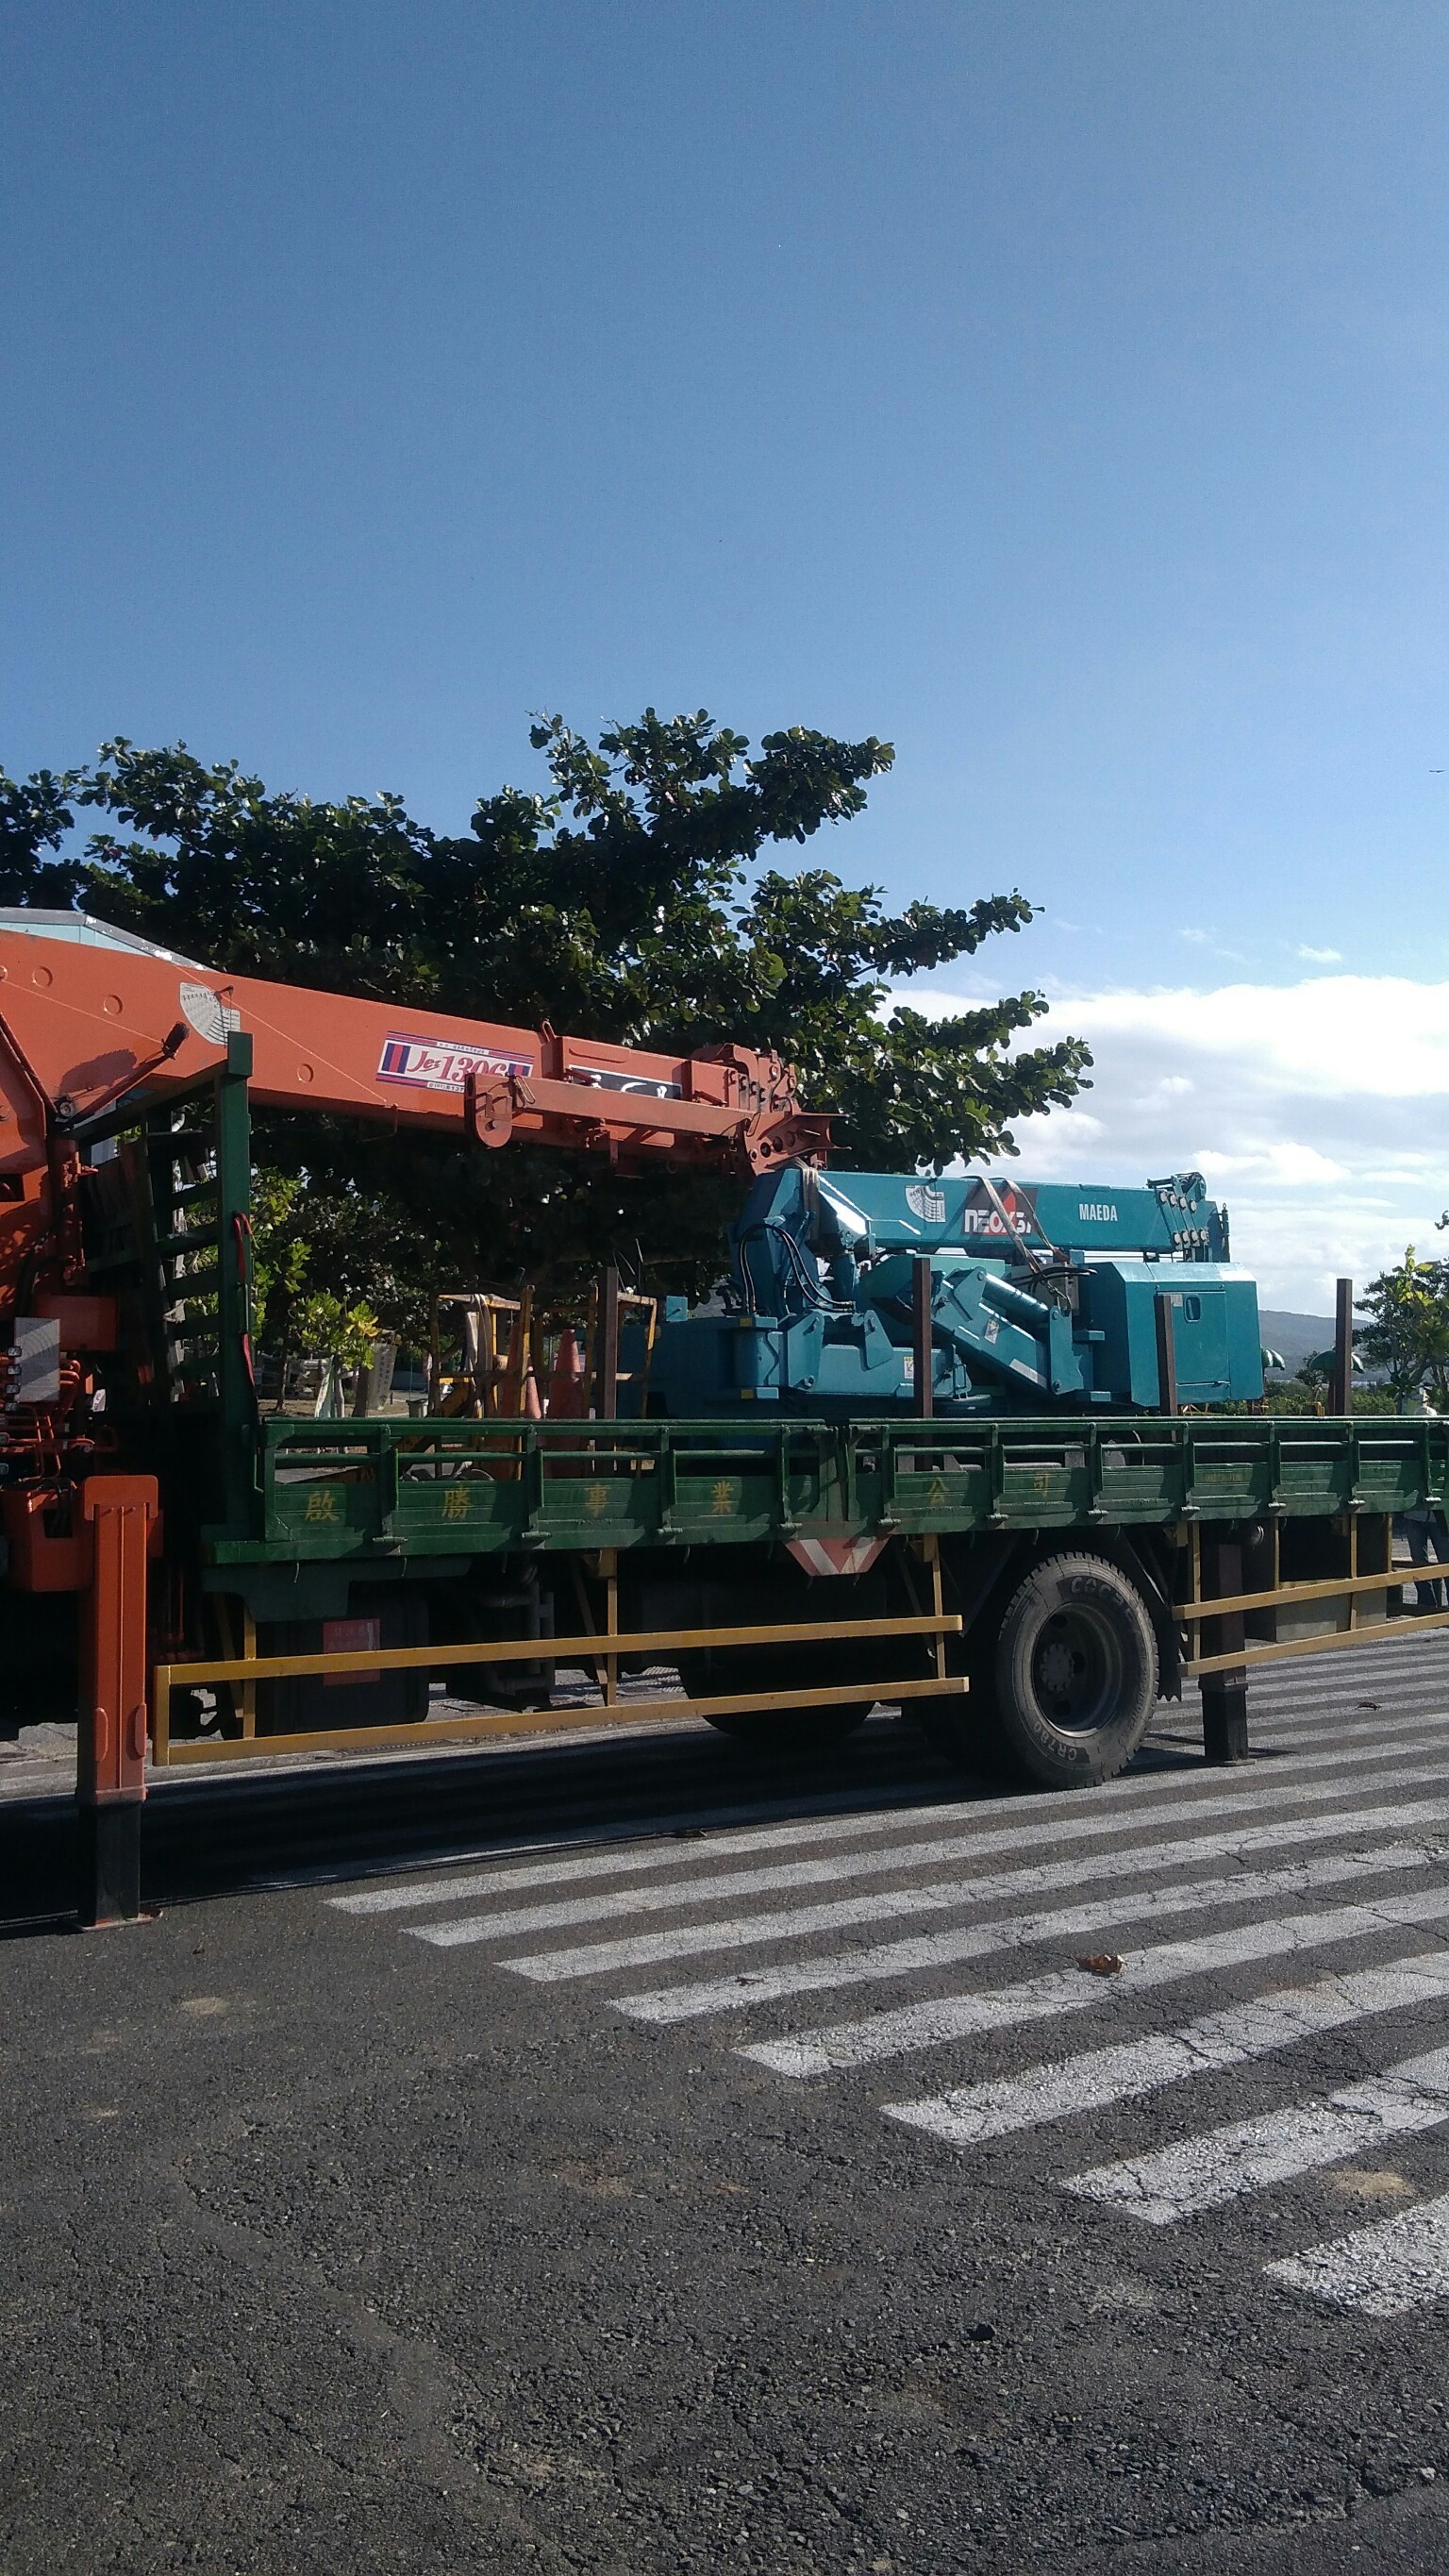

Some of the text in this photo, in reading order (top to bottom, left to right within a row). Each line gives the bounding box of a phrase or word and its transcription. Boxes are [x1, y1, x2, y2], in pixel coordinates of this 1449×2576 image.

[1079, 1203, 1118, 1221] MAEDA
[441, 1486, 471, 1518] 勝
[584, 1482, 611, 1517] 事
[711, 1480, 734, 1514] 業
[929, 1477, 950, 1505] 公
[1034, 1474, 1048, 1497] 司
